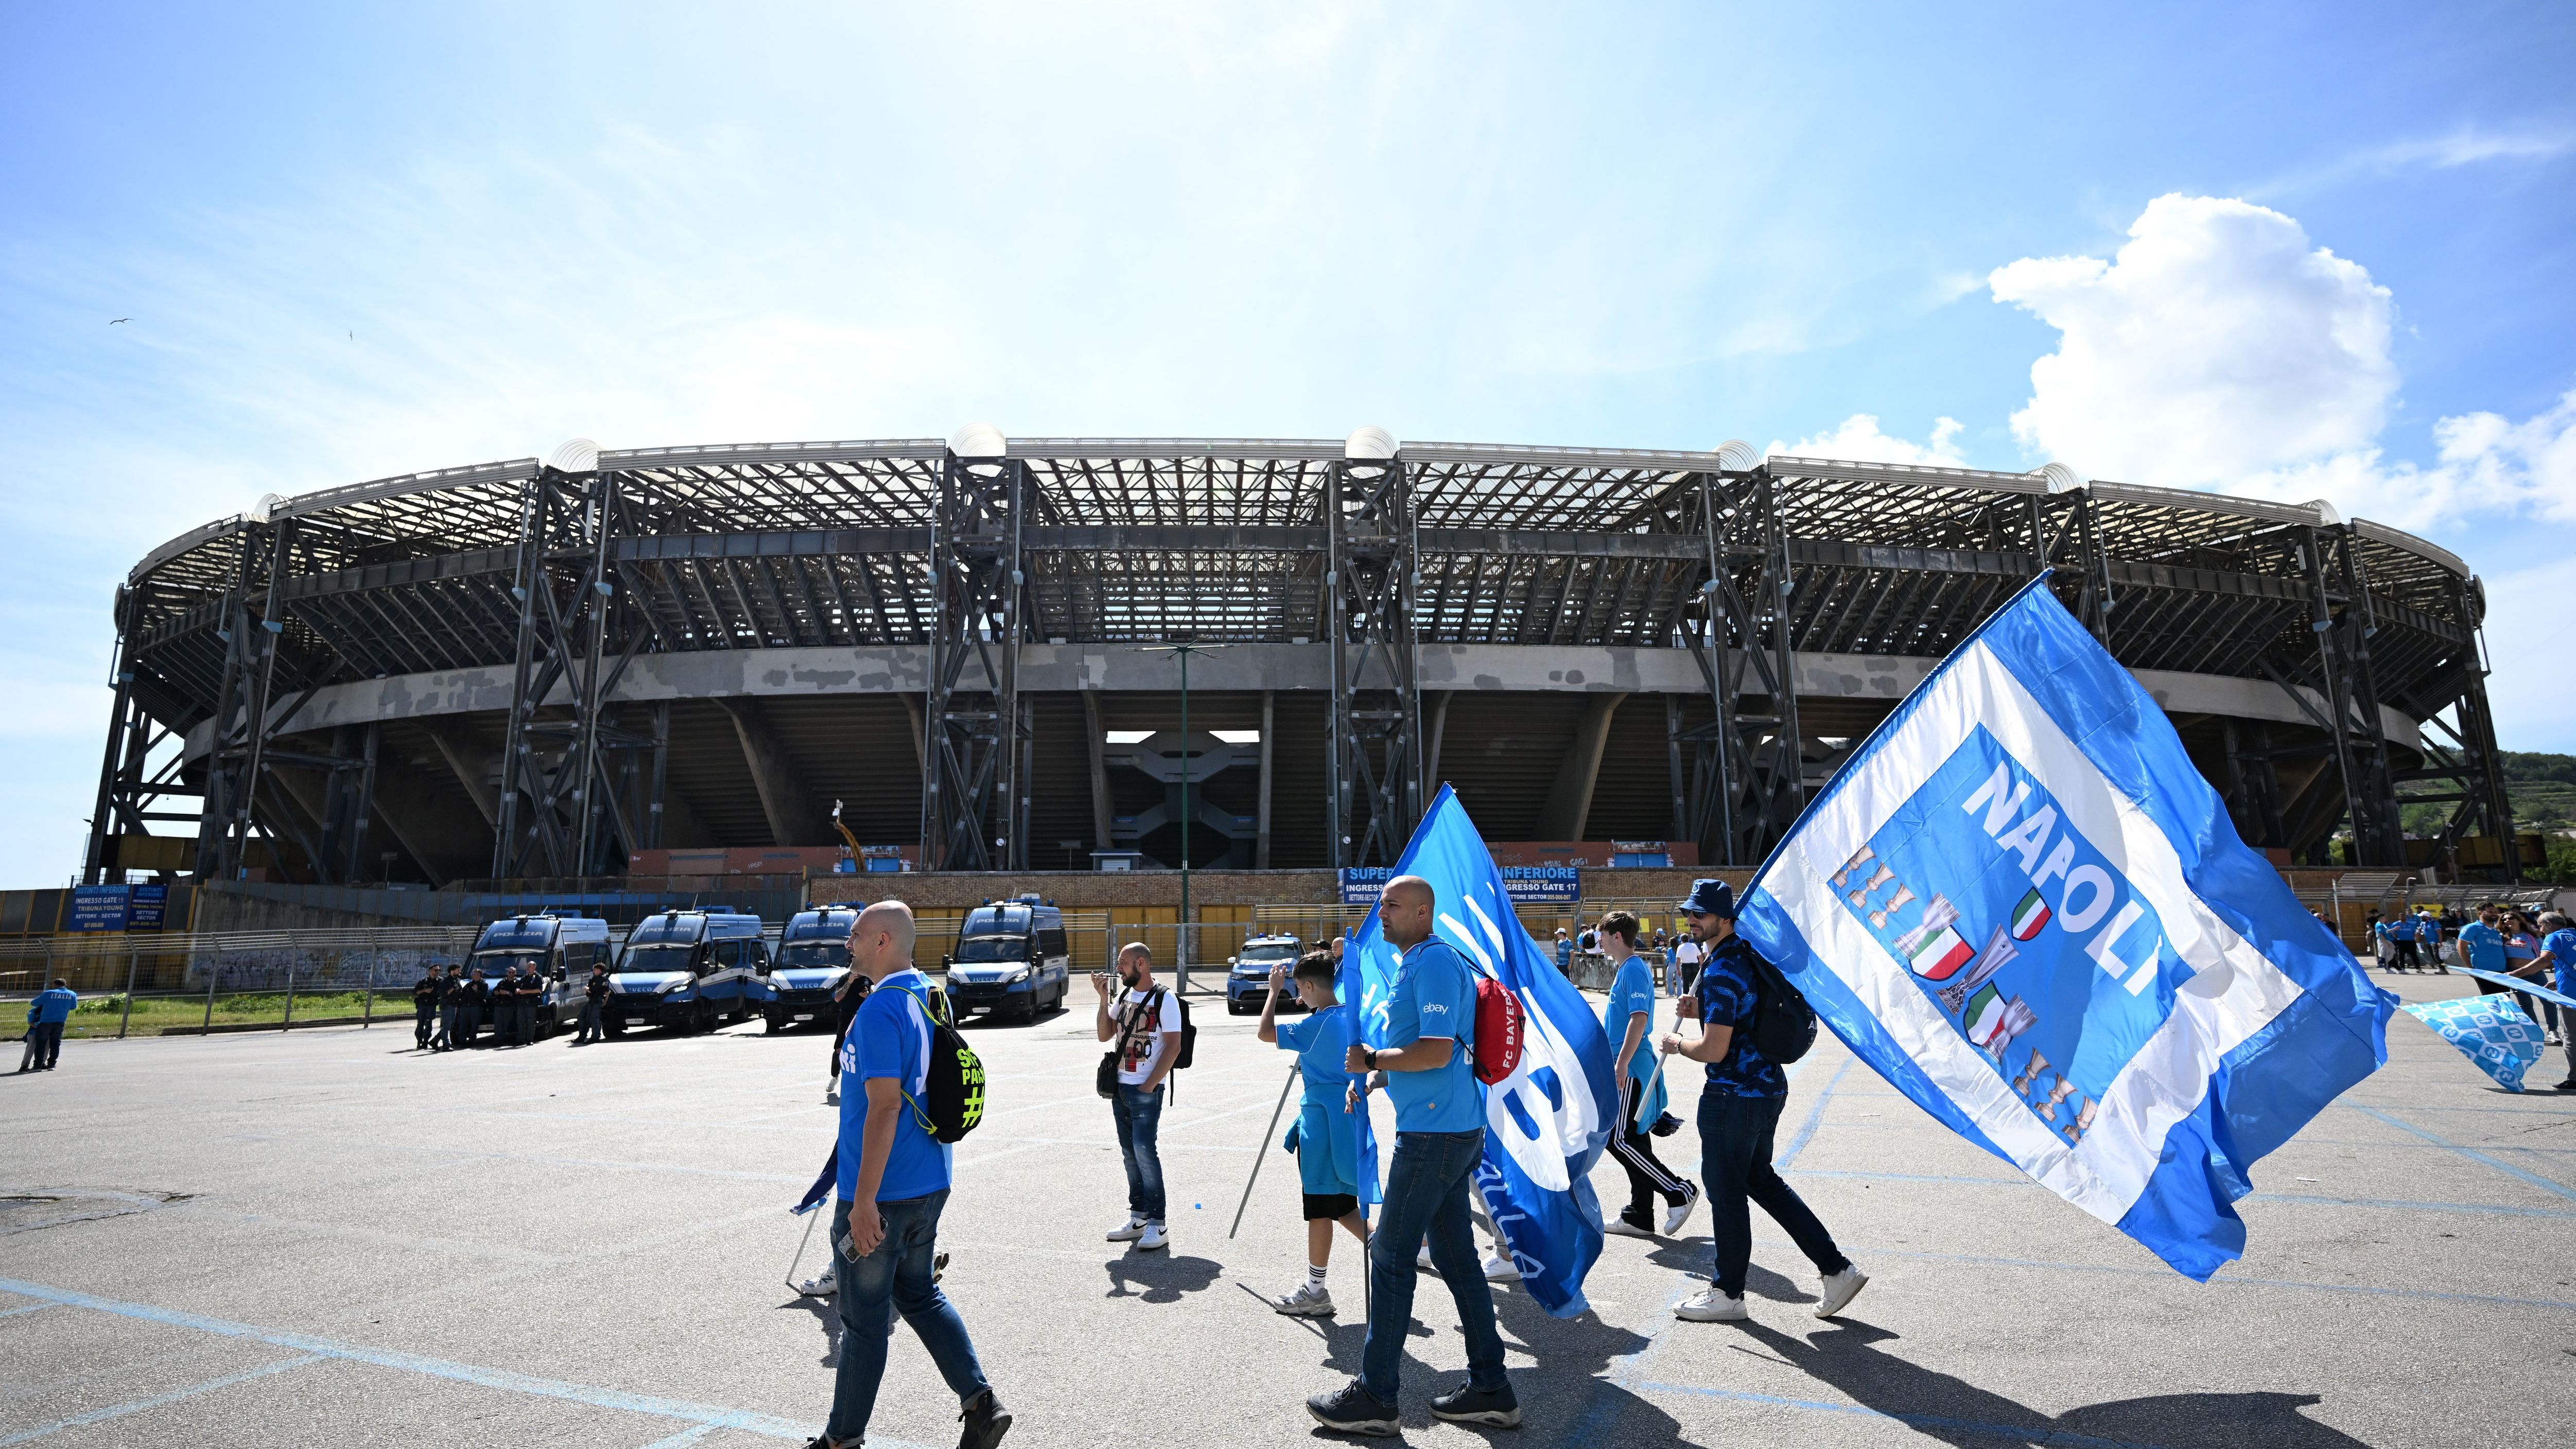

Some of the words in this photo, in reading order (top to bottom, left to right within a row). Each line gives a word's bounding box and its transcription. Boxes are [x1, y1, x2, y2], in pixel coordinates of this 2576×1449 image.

[1499, 867, 1576, 879] INFERIORE
[1961, 759, 2162, 998] NAPOLI
[76, 886, 99, 895] DISTINTI
[99, 885, 129, 894] INFERIORE
[1631, 991, 1647, 1000] ebay
[1423, 1002, 1449, 1015] ebay
[1503, 1050, 1513, 1069] FC
